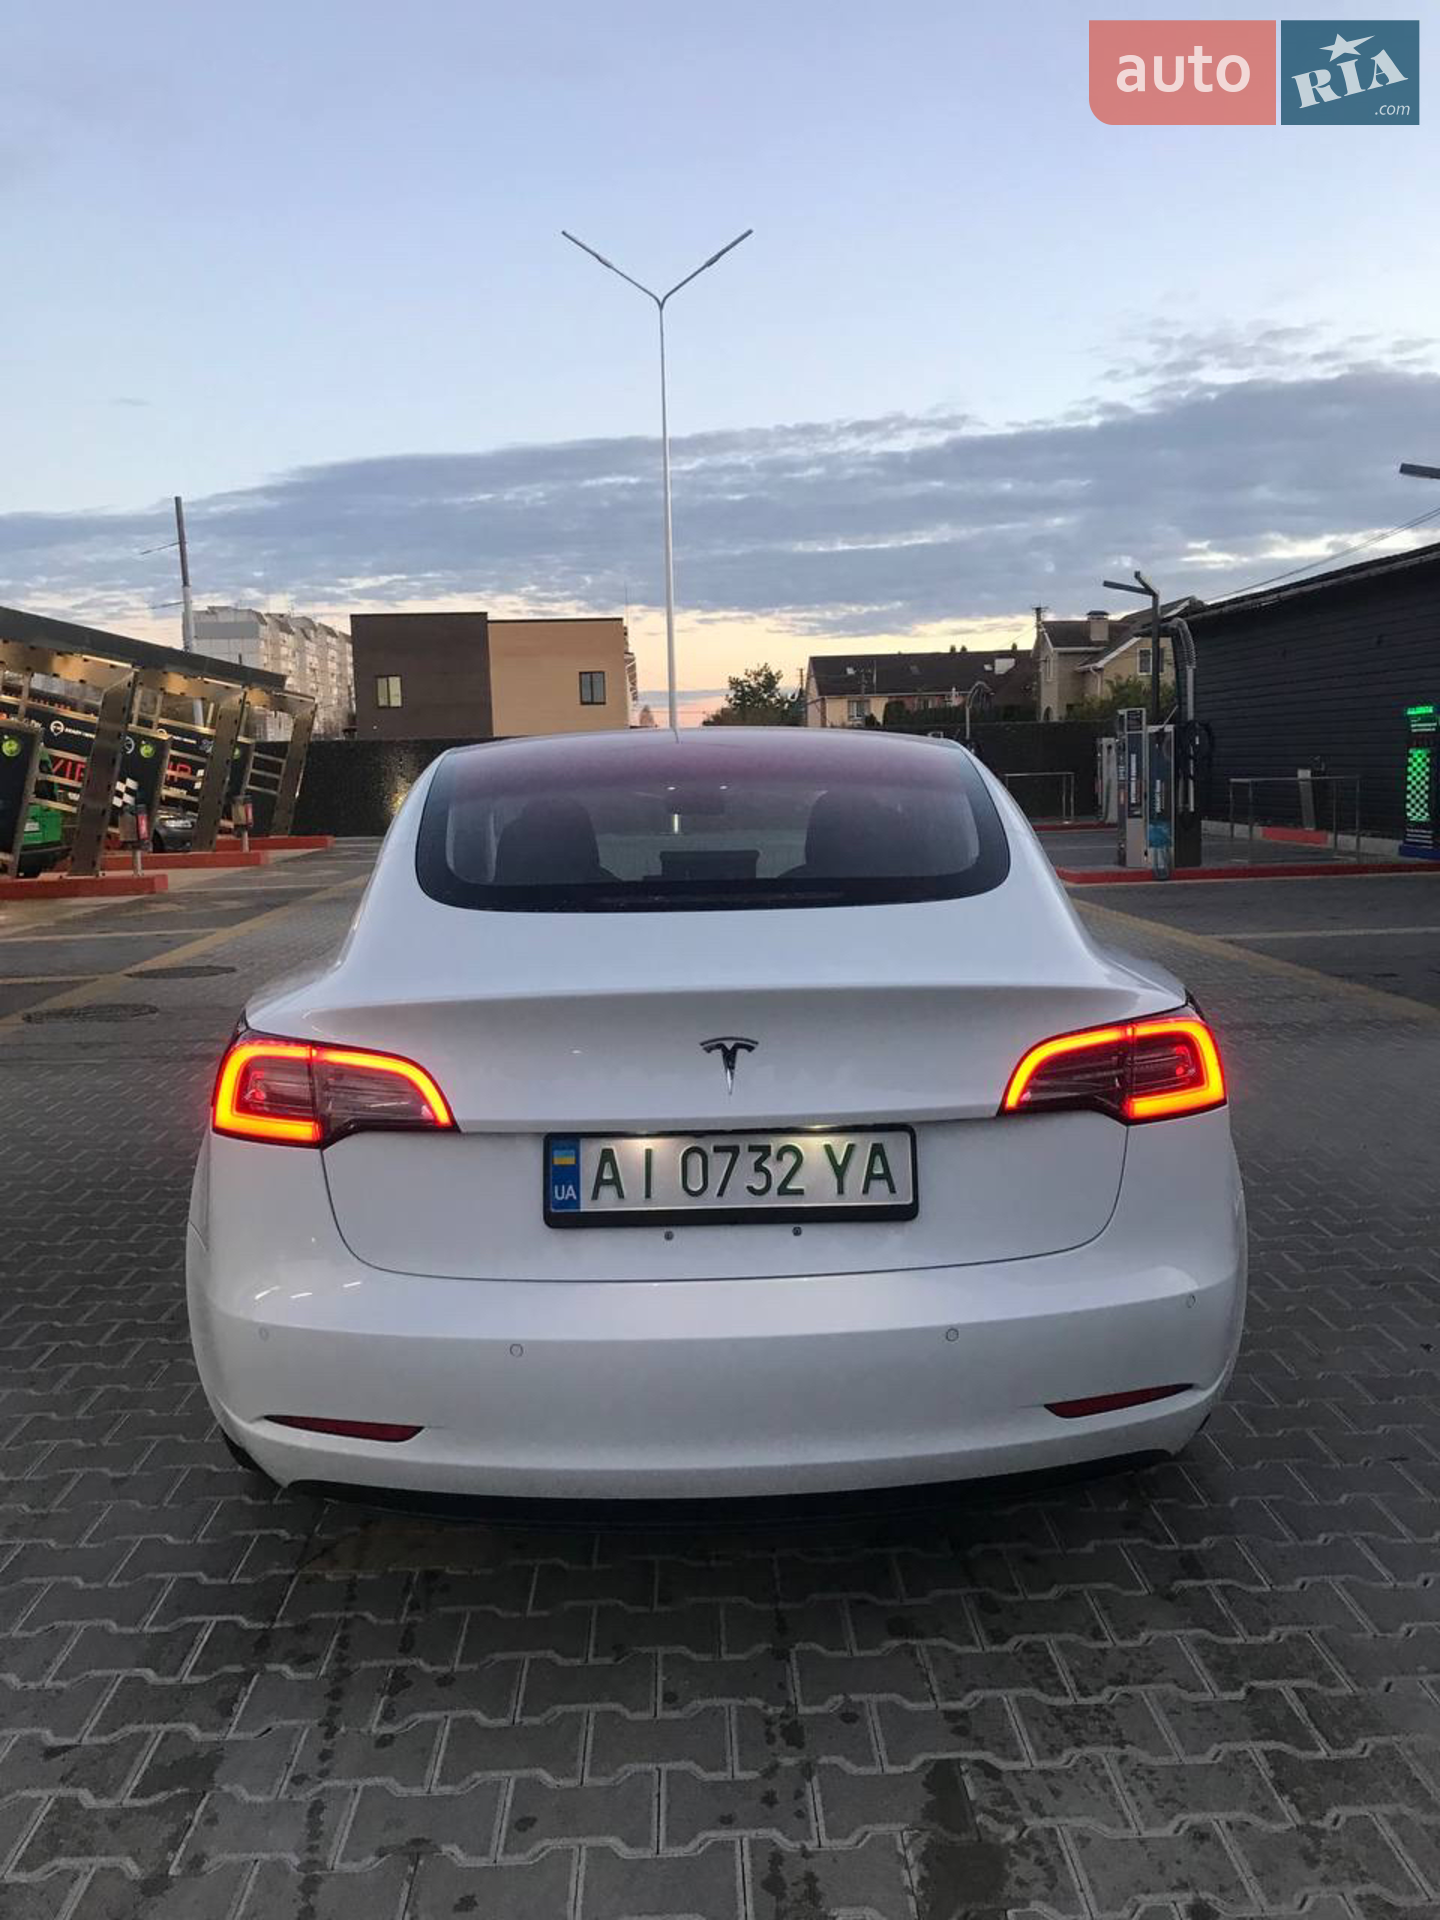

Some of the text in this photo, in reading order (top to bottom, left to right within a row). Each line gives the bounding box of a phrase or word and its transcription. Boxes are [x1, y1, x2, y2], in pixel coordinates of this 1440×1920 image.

[591, 1142, 897, 1200] AI 0732 YA
[554, 1184, 577, 1201] UA
